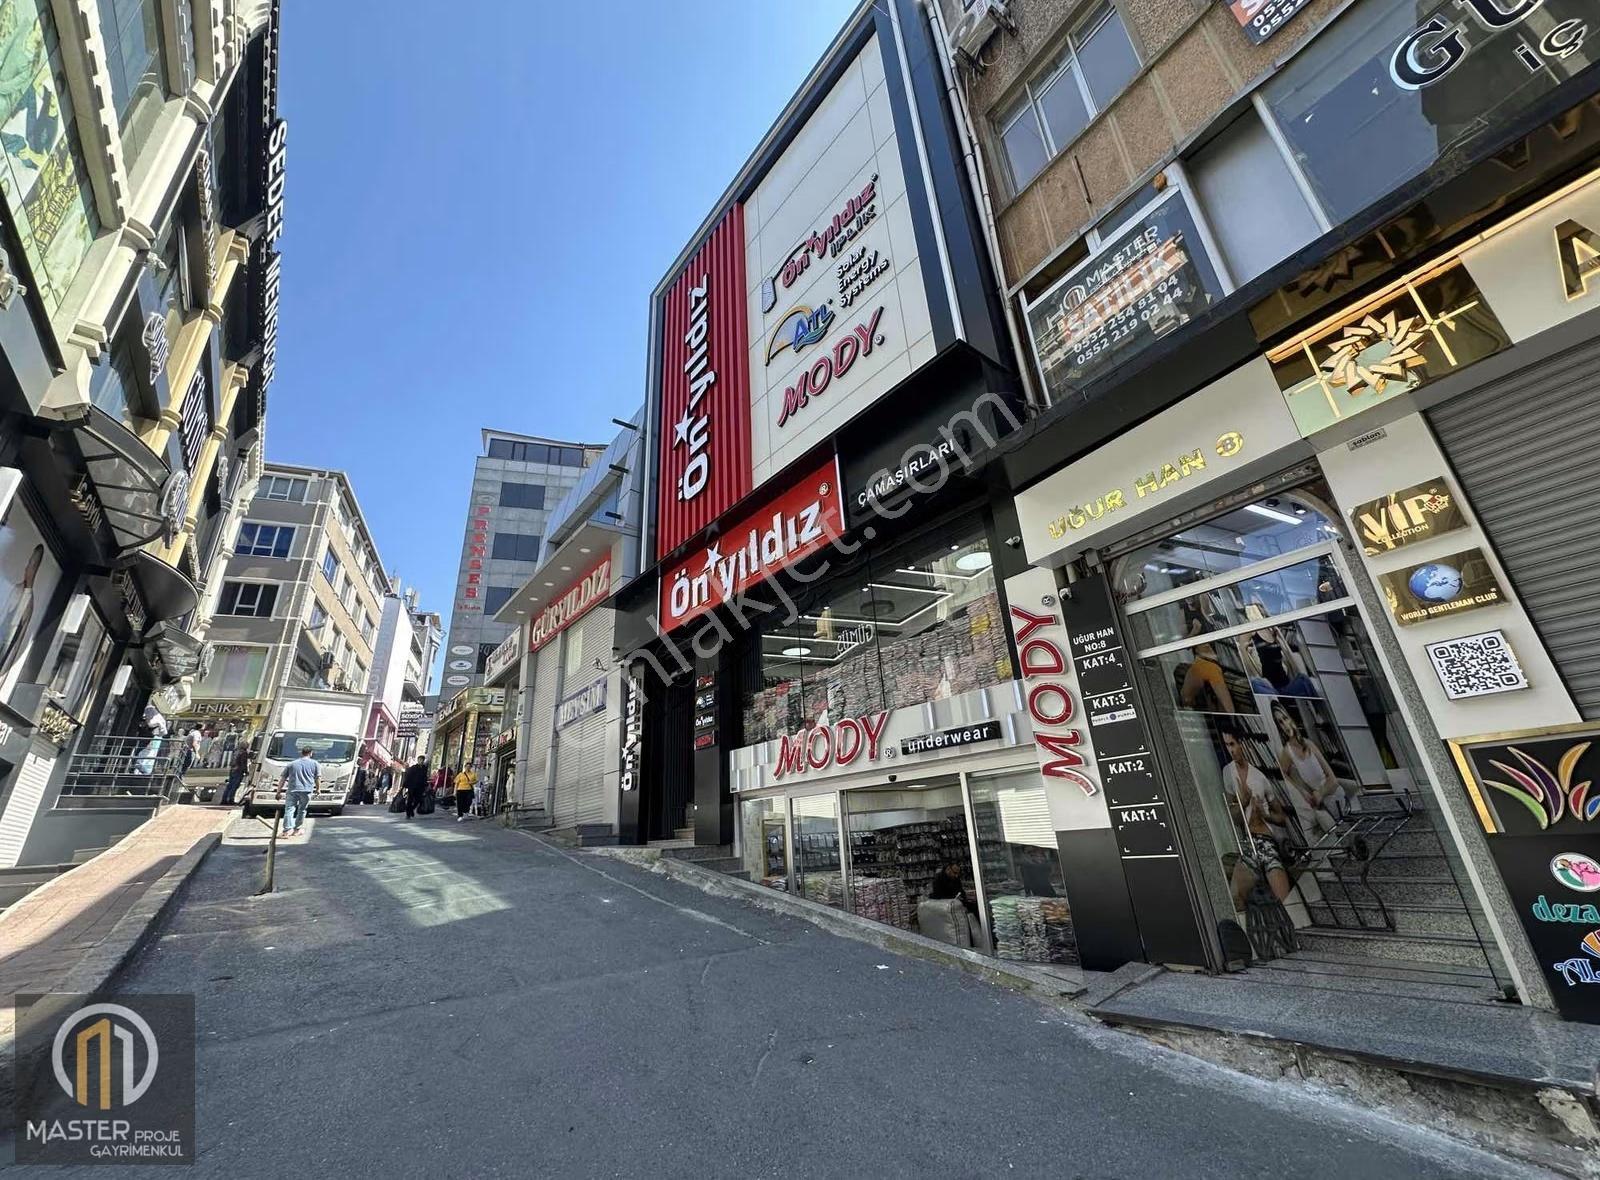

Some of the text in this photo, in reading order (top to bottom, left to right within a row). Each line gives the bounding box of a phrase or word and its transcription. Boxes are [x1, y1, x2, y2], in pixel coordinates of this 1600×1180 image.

[267, 120, 288, 249] SEDEF
[837, 245, 866, 279] Solar
[838, 250, 879, 294] Energy
[1086, 225, 1159, 288] MASTER
[840, 257, 890, 308] Systems
[1073, 275, 1178, 353] 0532 254 81 04
[1077, 288, 1183, 365] 0552 219 02 44
[777, 306, 884, 427] MODY
[858, 440, 955, 508] ÇAMAŞIRLARI
[1048, 488, 1128, 540] UĞUR
[1134, 448, 1207, 498] HAN
[1359, 494, 1434, 541] VIP
[1376, 524, 1429, 544] COLLECTION
[532, 561, 610, 645] GÜRYILDIZ
[1401, 592, 1498, 621] WORLD GENTLEMAN CLUB
[1073, 627, 1115, 645] UĞUR HAN
[1084, 640, 1107, 653] NO:8
[1083, 653, 1116, 670] KAT:4
[1010, 604, 1097, 797] MODY
[1092, 694, 1127, 710] KAT:3
[773, 710, 889, 780] MODY
[908, 724, 989, 753] underwear
[1108, 760, 1145, 774] KAT:2
[1121, 809, 1158, 823] KAT:1
